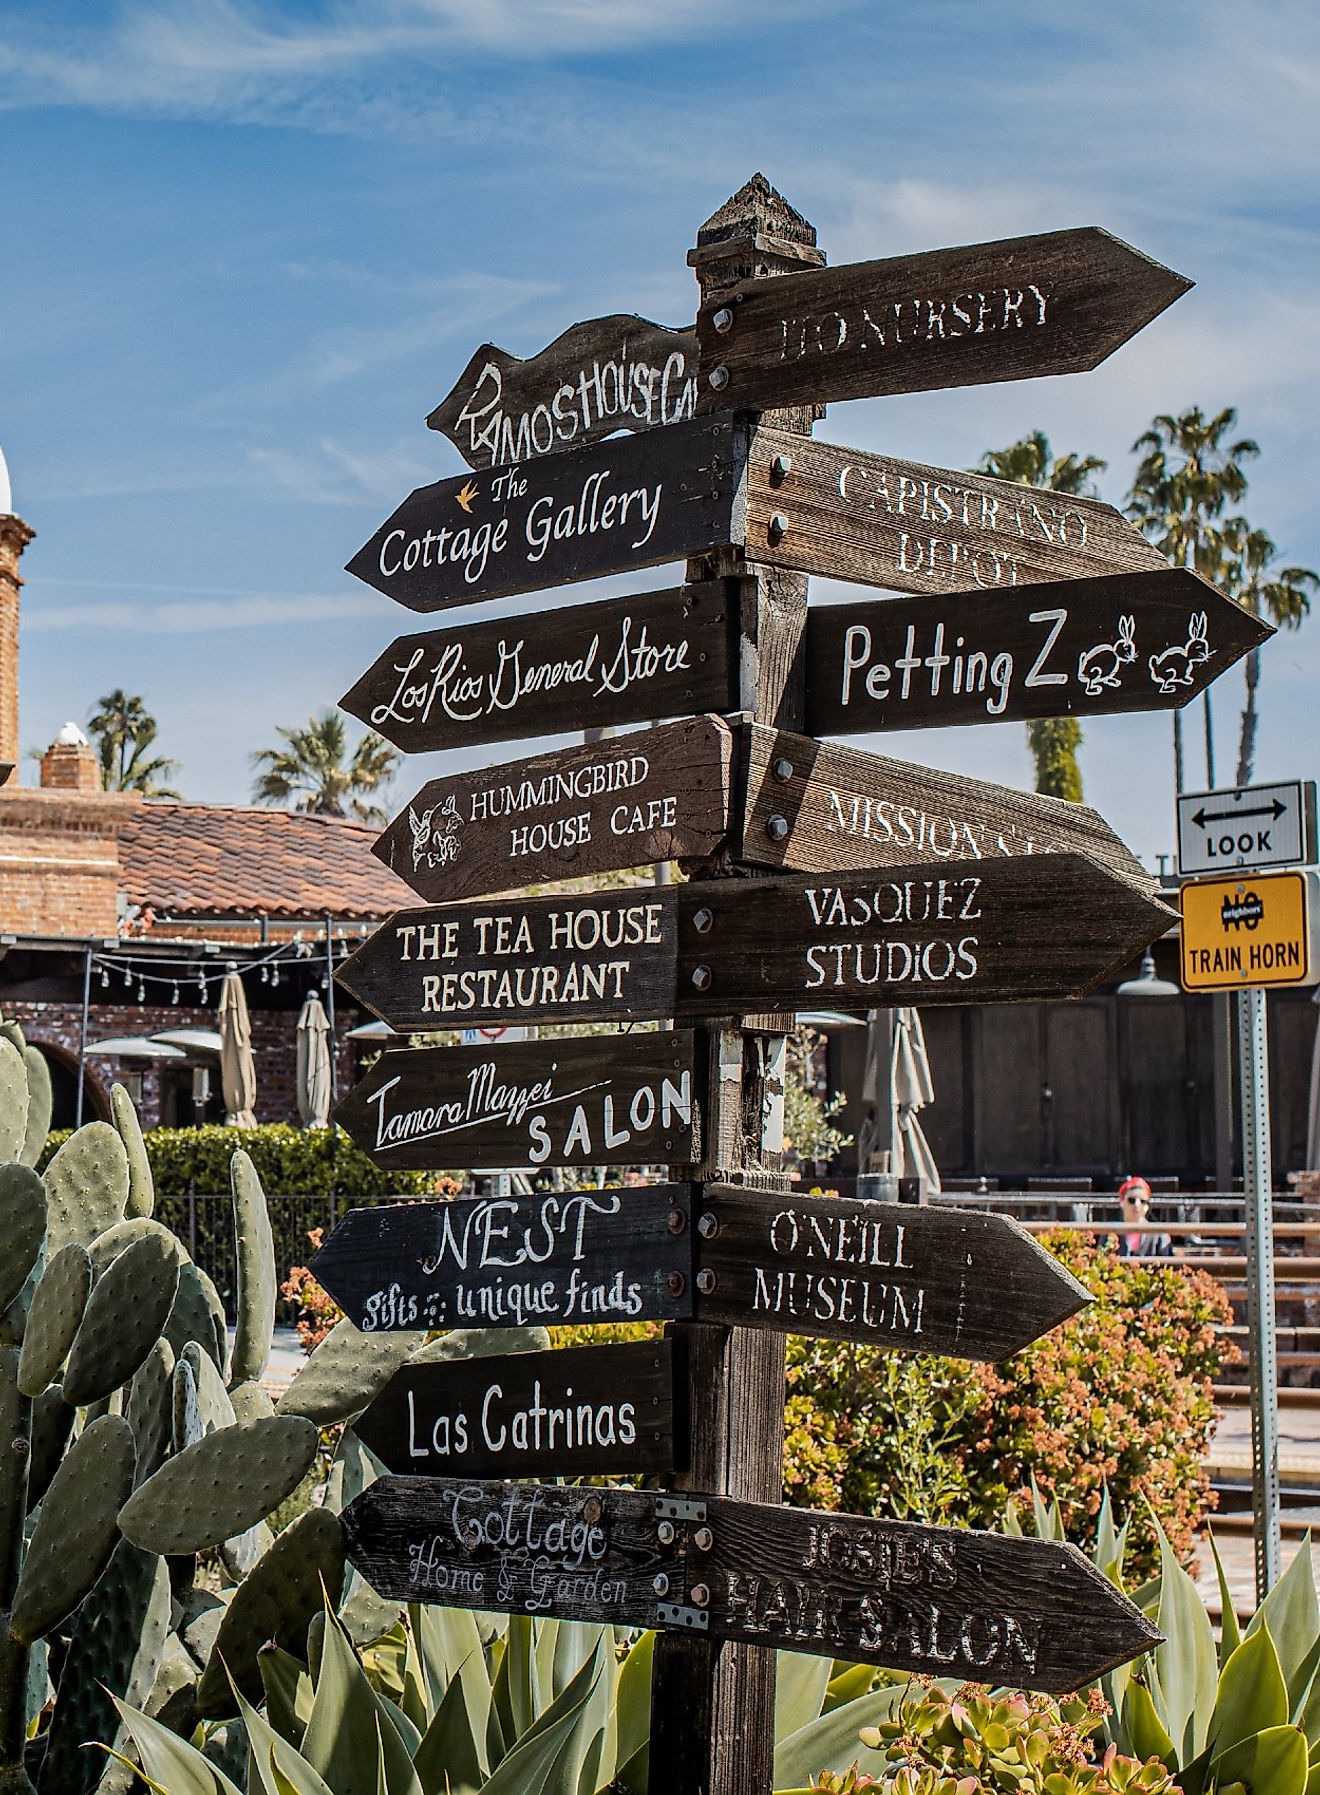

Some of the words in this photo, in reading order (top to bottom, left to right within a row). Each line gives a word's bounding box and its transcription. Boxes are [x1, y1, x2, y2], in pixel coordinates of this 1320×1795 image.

[860, 285, 1051, 349] NURSERY
[454, 361, 579, 466] RAMOS
[577, 338, 661, 430] HOUSE
[491, 467, 528, 502] The
[839, 466, 1087, 547] CAPISTRANO
[379, 518, 509, 584] Cottage
[526, 470, 663, 562] Gallery
[898, 531, 1018, 588] DEPOT
[370, 647, 428, 724] Los
[421, 642, 483, 724] Rios
[484, 639, 602, 715] General
[592, 616, 692, 698] Store
[841, 624, 1013, 715] Petting
[1024, 608, 1068, 688] Z
[469, 755, 650, 823] HUMMINGBIRD
[508, 811, 592, 857] HOUSE
[610, 796, 679, 836] CAFE
[827, 790, 984, 860] MISSION
[1206, 830, 1273, 858] LOOK
[396, 921, 460, 961] THE
[473, 915, 535, 955] TEA
[548, 903, 664, 950] HOUSE
[805, 877, 983, 926] VASQUEZ
[421, 961, 630, 1013] RESTAURANT
[805, 936, 979, 989] STUDIOS
[1189, 947, 1242, 974] TRAIN
[1249, 941, 1300, 969] HORN
[367, 1075, 466, 1148] Tamara
[528, 1069, 691, 1163] SALON
[420, 1195, 622, 1275] NEST
[362, 1282, 418, 1332] gifts
[456, 1277, 560, 1326] unique
[562, 1267, 644, 1318] finds
[752, 1267, 926, 1334] MUSEUM
[407, 1390, 469, 1458] Las
[481, 1379, 637, 1452] Catrinas
[443, 1485, 607, 1566] Cottage
[409, 1536, 485, 1592] Home
[524, 1555, 627, 1611] Garden
[727, 1570, 845, 1647] HAIR
[858, 1595, 1044, 1676] SALON
